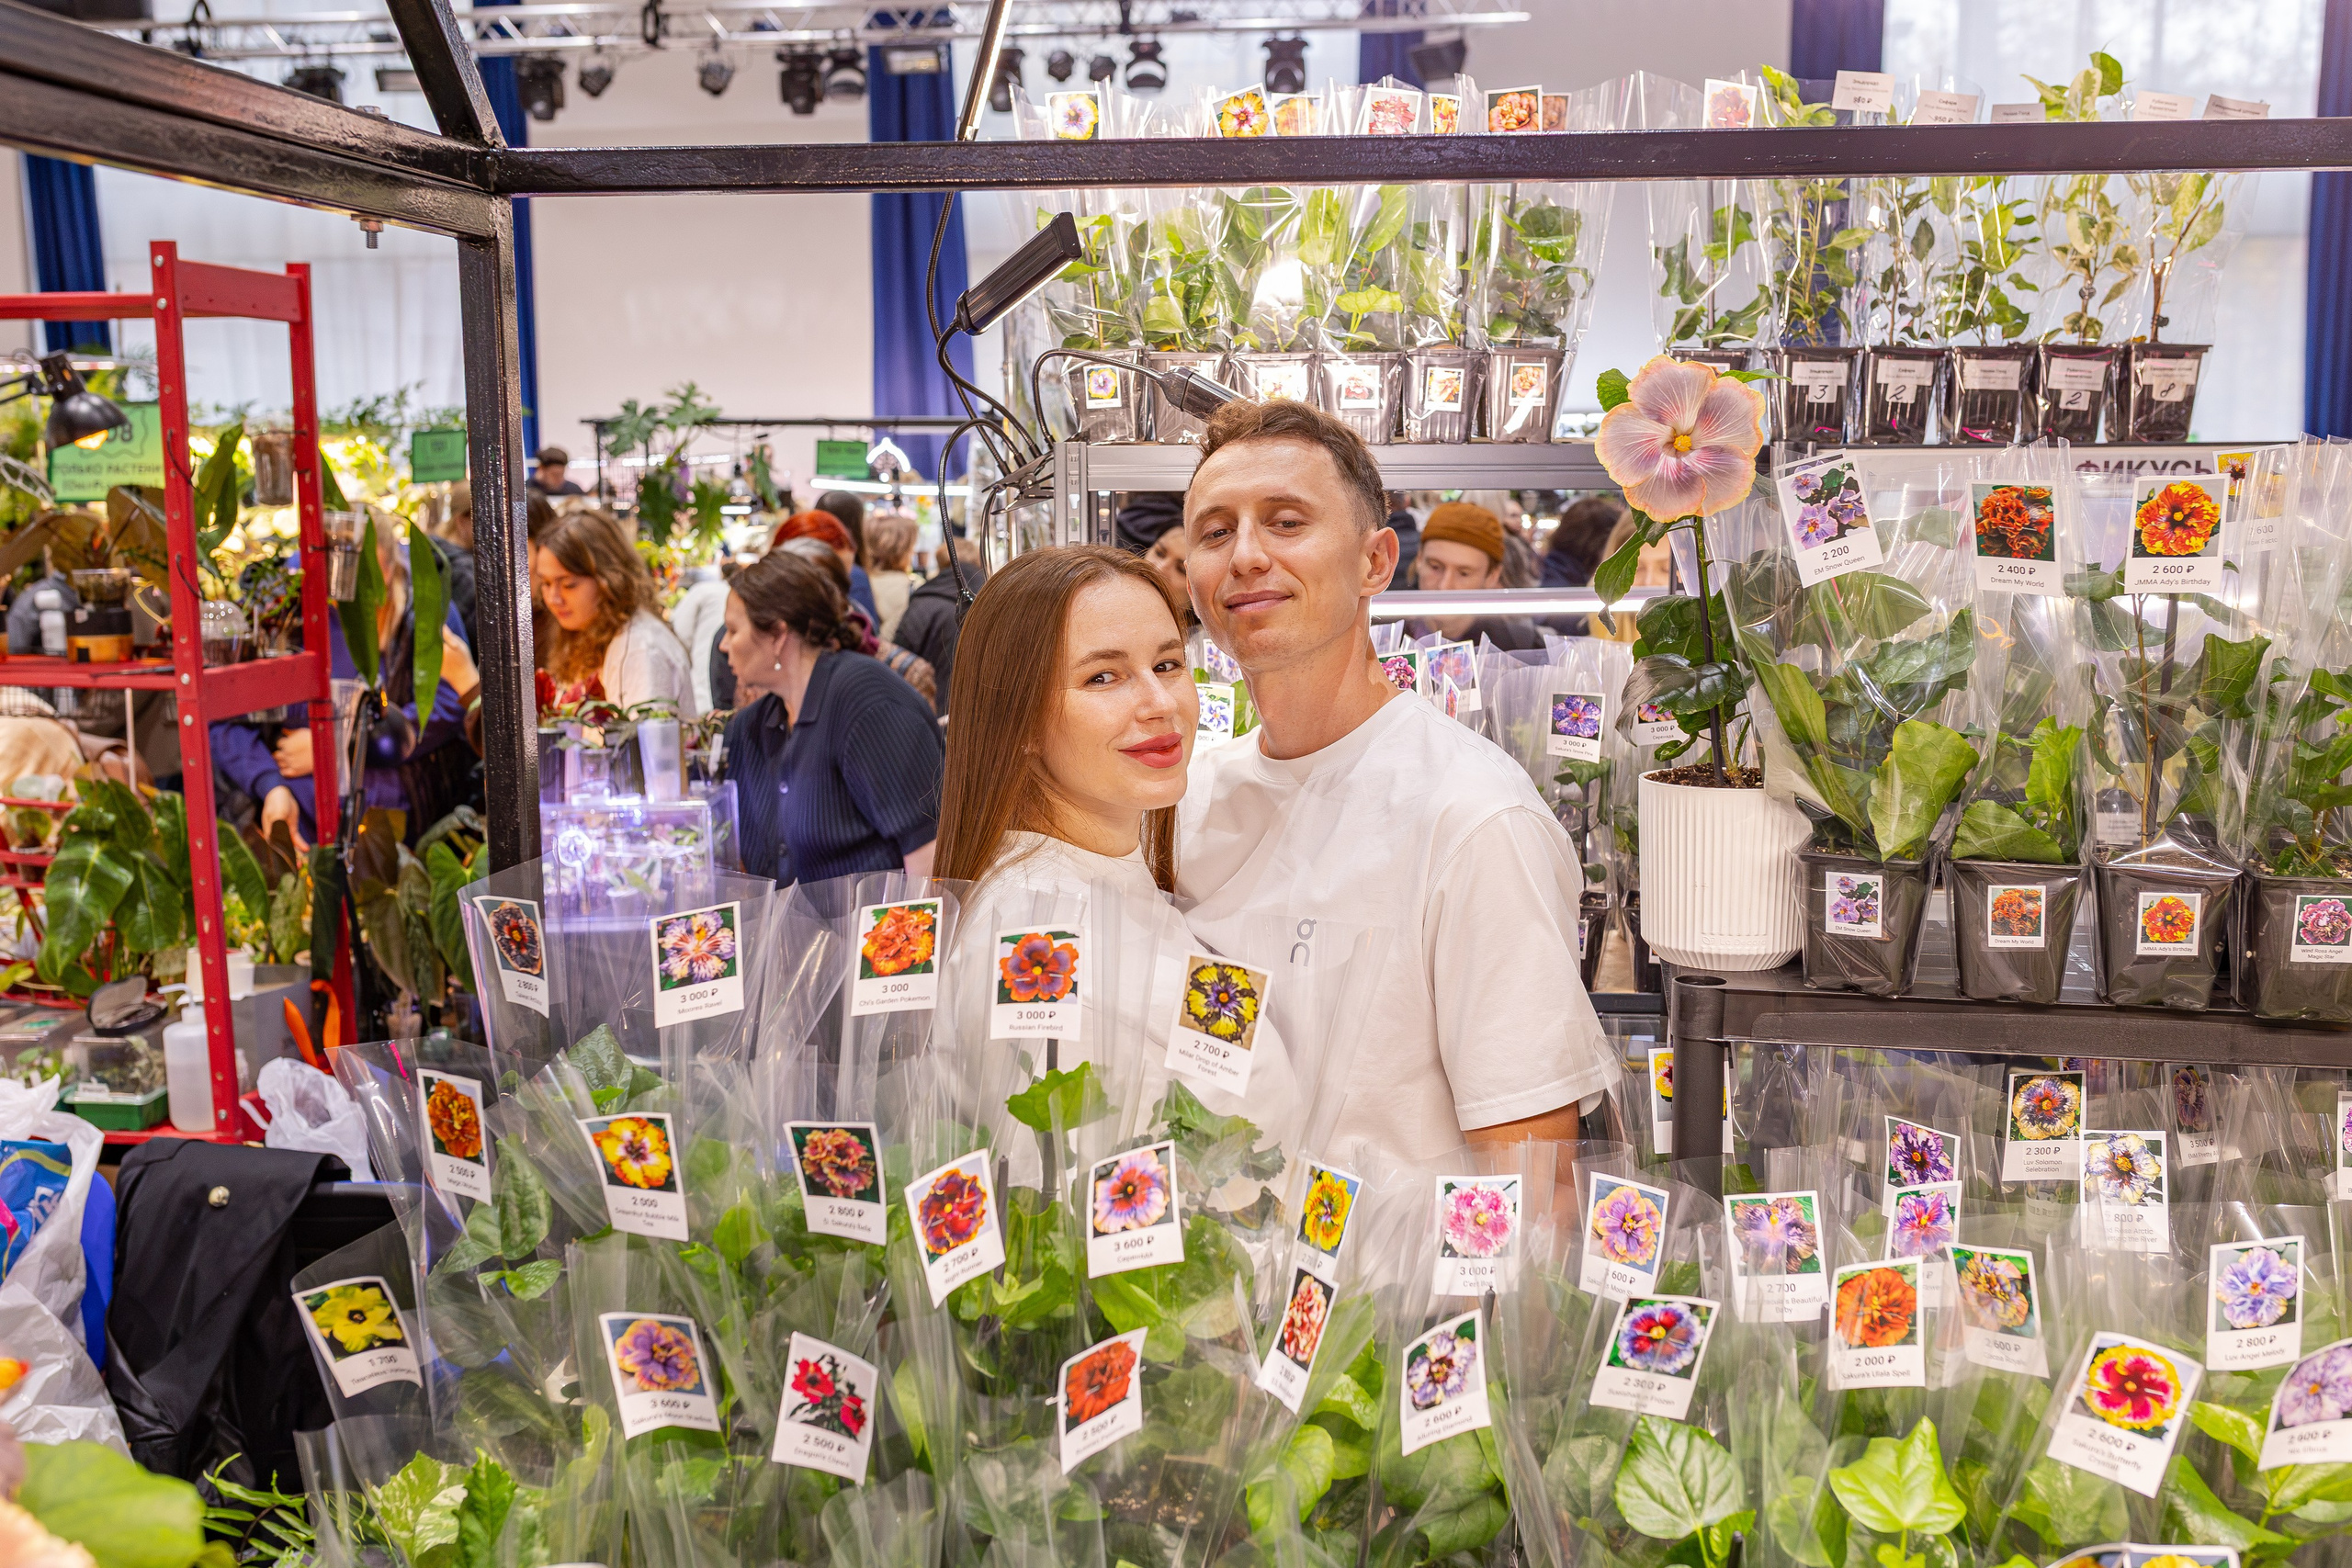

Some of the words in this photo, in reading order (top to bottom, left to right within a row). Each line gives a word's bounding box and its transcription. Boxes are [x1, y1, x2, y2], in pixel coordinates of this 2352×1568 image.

[1814, 384, 1829, 400] 3
[107, 463, 162, 475] РАСТЕНИ
[1822, 551, 1829, 560] 2
[1830, 545, 1849, 558] 200
[1814, 567, 1825, 576] EM
[1826, 561, 1843, 572] Snow
[1844, 555, 1865, 567] Queen
[1997, 564, 2004, 573] 2
[2007, 565, 2026, 575] 400
[2153, 565, 2159, 574] 2
[2163, 565, 2183, 574] 600
[2025, 580, 2044, 588] World
[882, 985, 888, 993] 3
[890, 983, 909, 993] 000
[681, 995, 687, 1003] 3
[689, 990, 708, 1001] 000
[1016, 1010, 1023, 1020] 3
[1026, 1010, 1046, 1020] 000
[1193, 1039, 1201, 1049] 2
[1203, 1042, 1221, 1056] 700
[1218, 1063, 1239, 1077] Amber
[2189, 1140, 2195, 1148] 3
[2195, 1139, 2208, 1148] 500
[2026, 1146, 2031, 1156] 2
[2033, 1146, 2052, 1156] 300
[631, 1196, 638, 1206] 2
[829, 1204, 835, 1214] 2
[2114, 1213, 2133, 1223] 800
[1114, 1242, 1120, 1252] 3
[1124, 1237, 1144, 1249] 600
[944, 1262, 949, 1273] 2
[951, 1251, 969, 1267] 700
[1459, 1267, 1465, 1276] 3
[1611, 1270, 1628, 1283] 600
[1611, 1283, 1626, 1294] Moon
[1767, 1284, 1774, 1293] 2
[1776, 1283, 1796, 1292] 700
[1791, 1295, 1823, 1304] Beautiful
[1994, 1339, 2011, 1351] 600
[2236, 1338, 2243, 1348] 2
[2246, 1337, 2267, 1348] 800
[1855, 1358, 1861, 1367] 2
[1864, 1356, 1884, 1367] 000
[1623, 1376, 1631, 1386] 2
[1424, 1417, 1430, 1427] 2
[1432, 1410, 1452, 1424] 600
[803, 1434, 810, 1444] 2
[813, 1436, 834, 1450] 500
[2087, 1428, 2097, 1439] 2
[2099, 1432, 2123, 1449] 600
[2288, 1436, 2295, 1444] 2
[2297, 1429, 2319, 1443] 600
